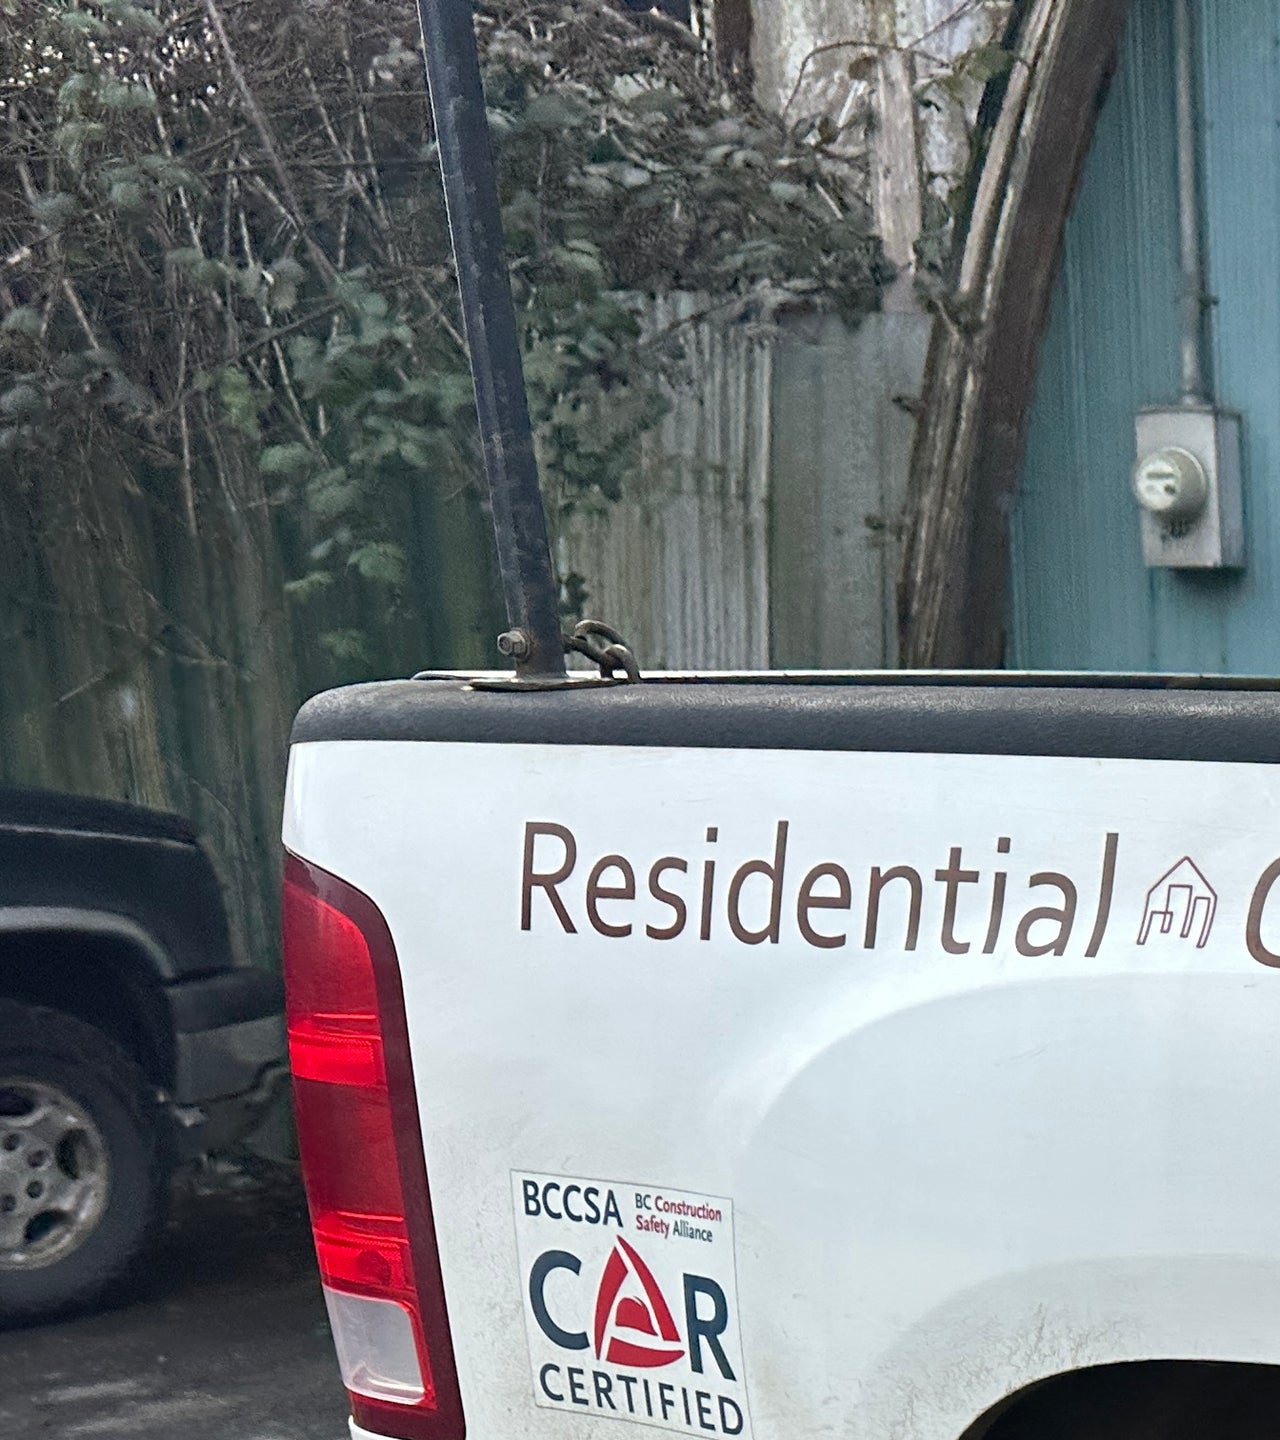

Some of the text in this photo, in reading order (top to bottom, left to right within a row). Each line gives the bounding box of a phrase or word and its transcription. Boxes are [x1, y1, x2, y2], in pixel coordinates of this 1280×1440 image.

[521, 821, 1118, 957] Residential
[522, 1179, 624, 1228] BCCSA
[634, 1192, 722, 1222] BC Construction
[635, 1214, 713, 1243] Safety Alliance
[539, 1363, 744, 1436] CERTIFIED
